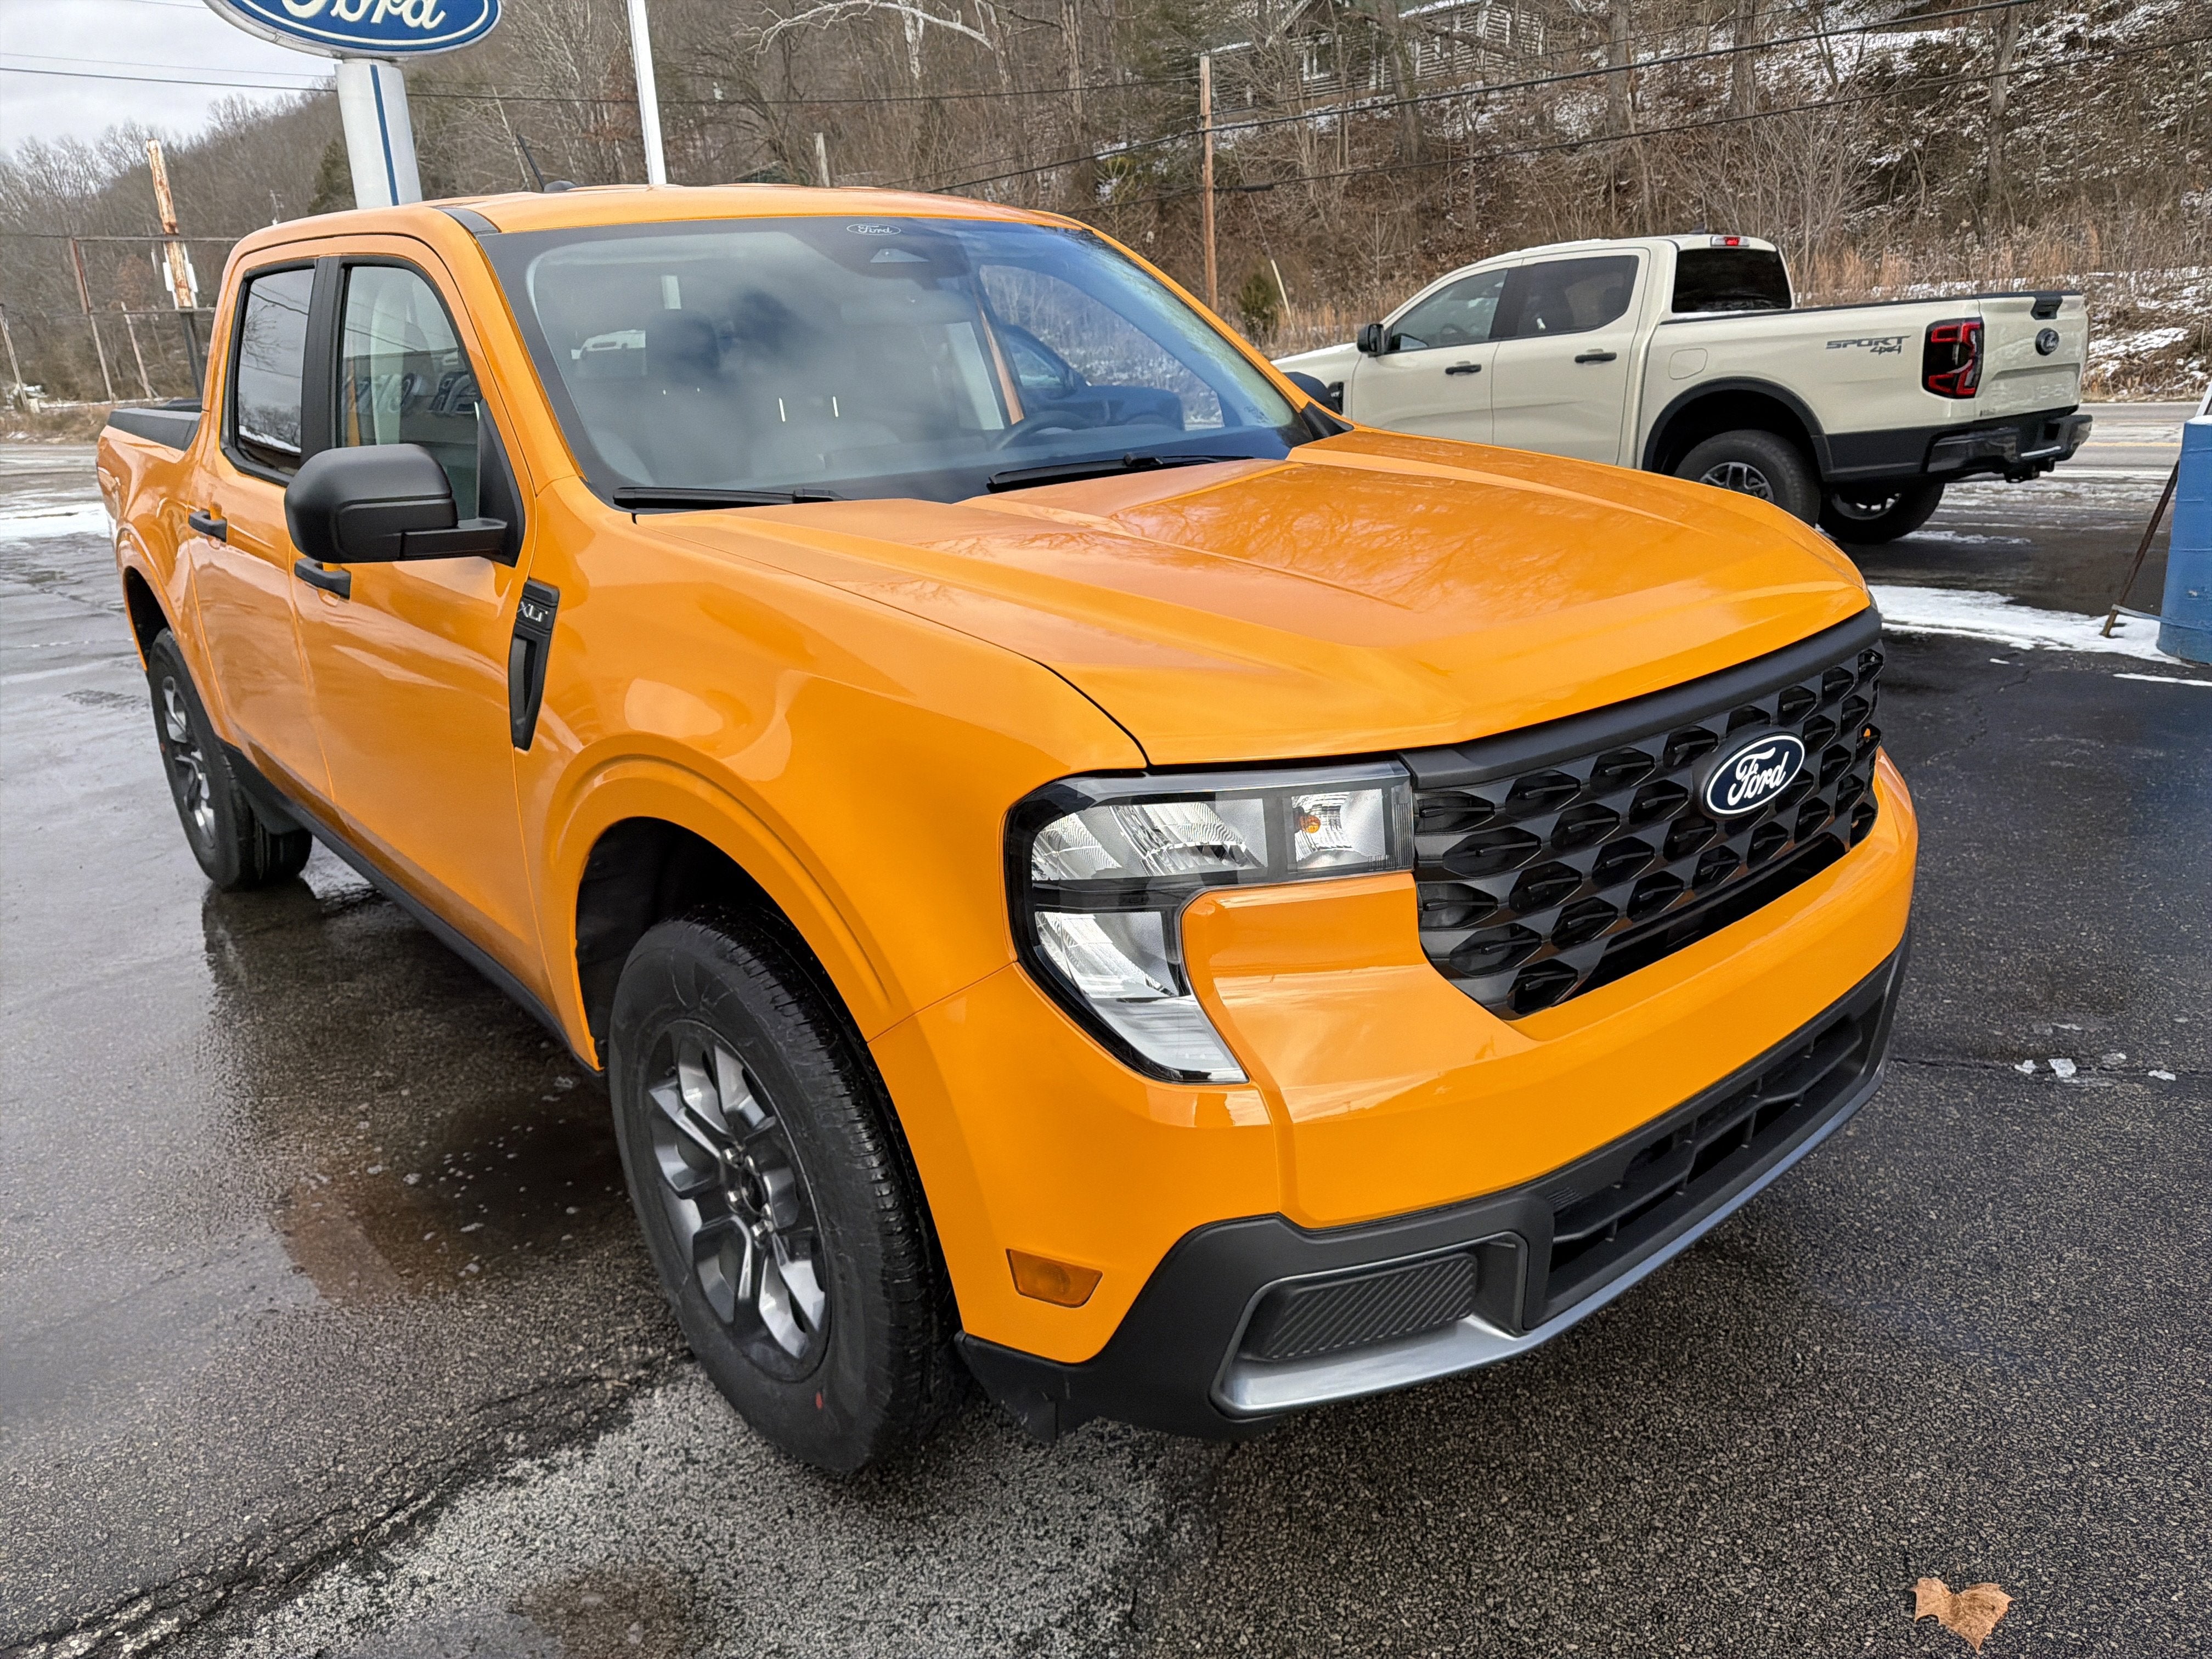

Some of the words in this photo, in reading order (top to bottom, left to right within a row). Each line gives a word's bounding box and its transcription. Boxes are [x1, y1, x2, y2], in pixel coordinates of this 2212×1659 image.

[857, 225, 893, 233] Ford
[1826, 335, 1911, 349] SPORT
[1870, 345, 1902, 356] 4x4
[517, 601, 549, 622] XLT
[1727, 747, 1790, 806] Ford
